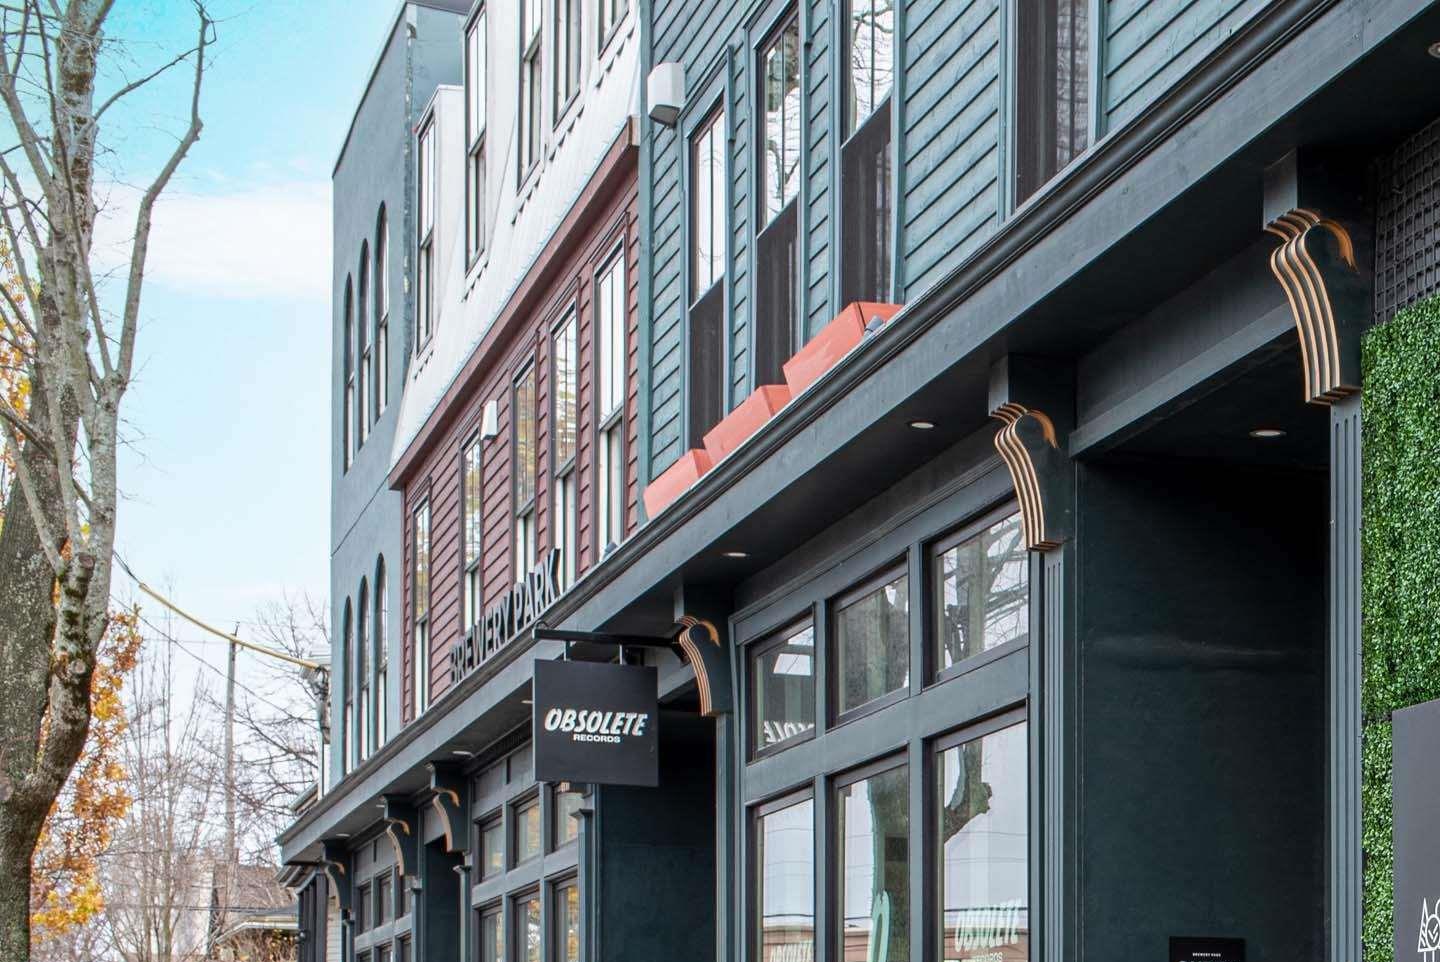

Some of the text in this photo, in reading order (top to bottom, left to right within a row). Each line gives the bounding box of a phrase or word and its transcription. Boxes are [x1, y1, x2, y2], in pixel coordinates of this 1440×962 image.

[450, 548, 562, 684] BREWERY PARK
[544, 708, 648, 736] OBSOLETE
[573, 733, 621, 743] RECORDS
